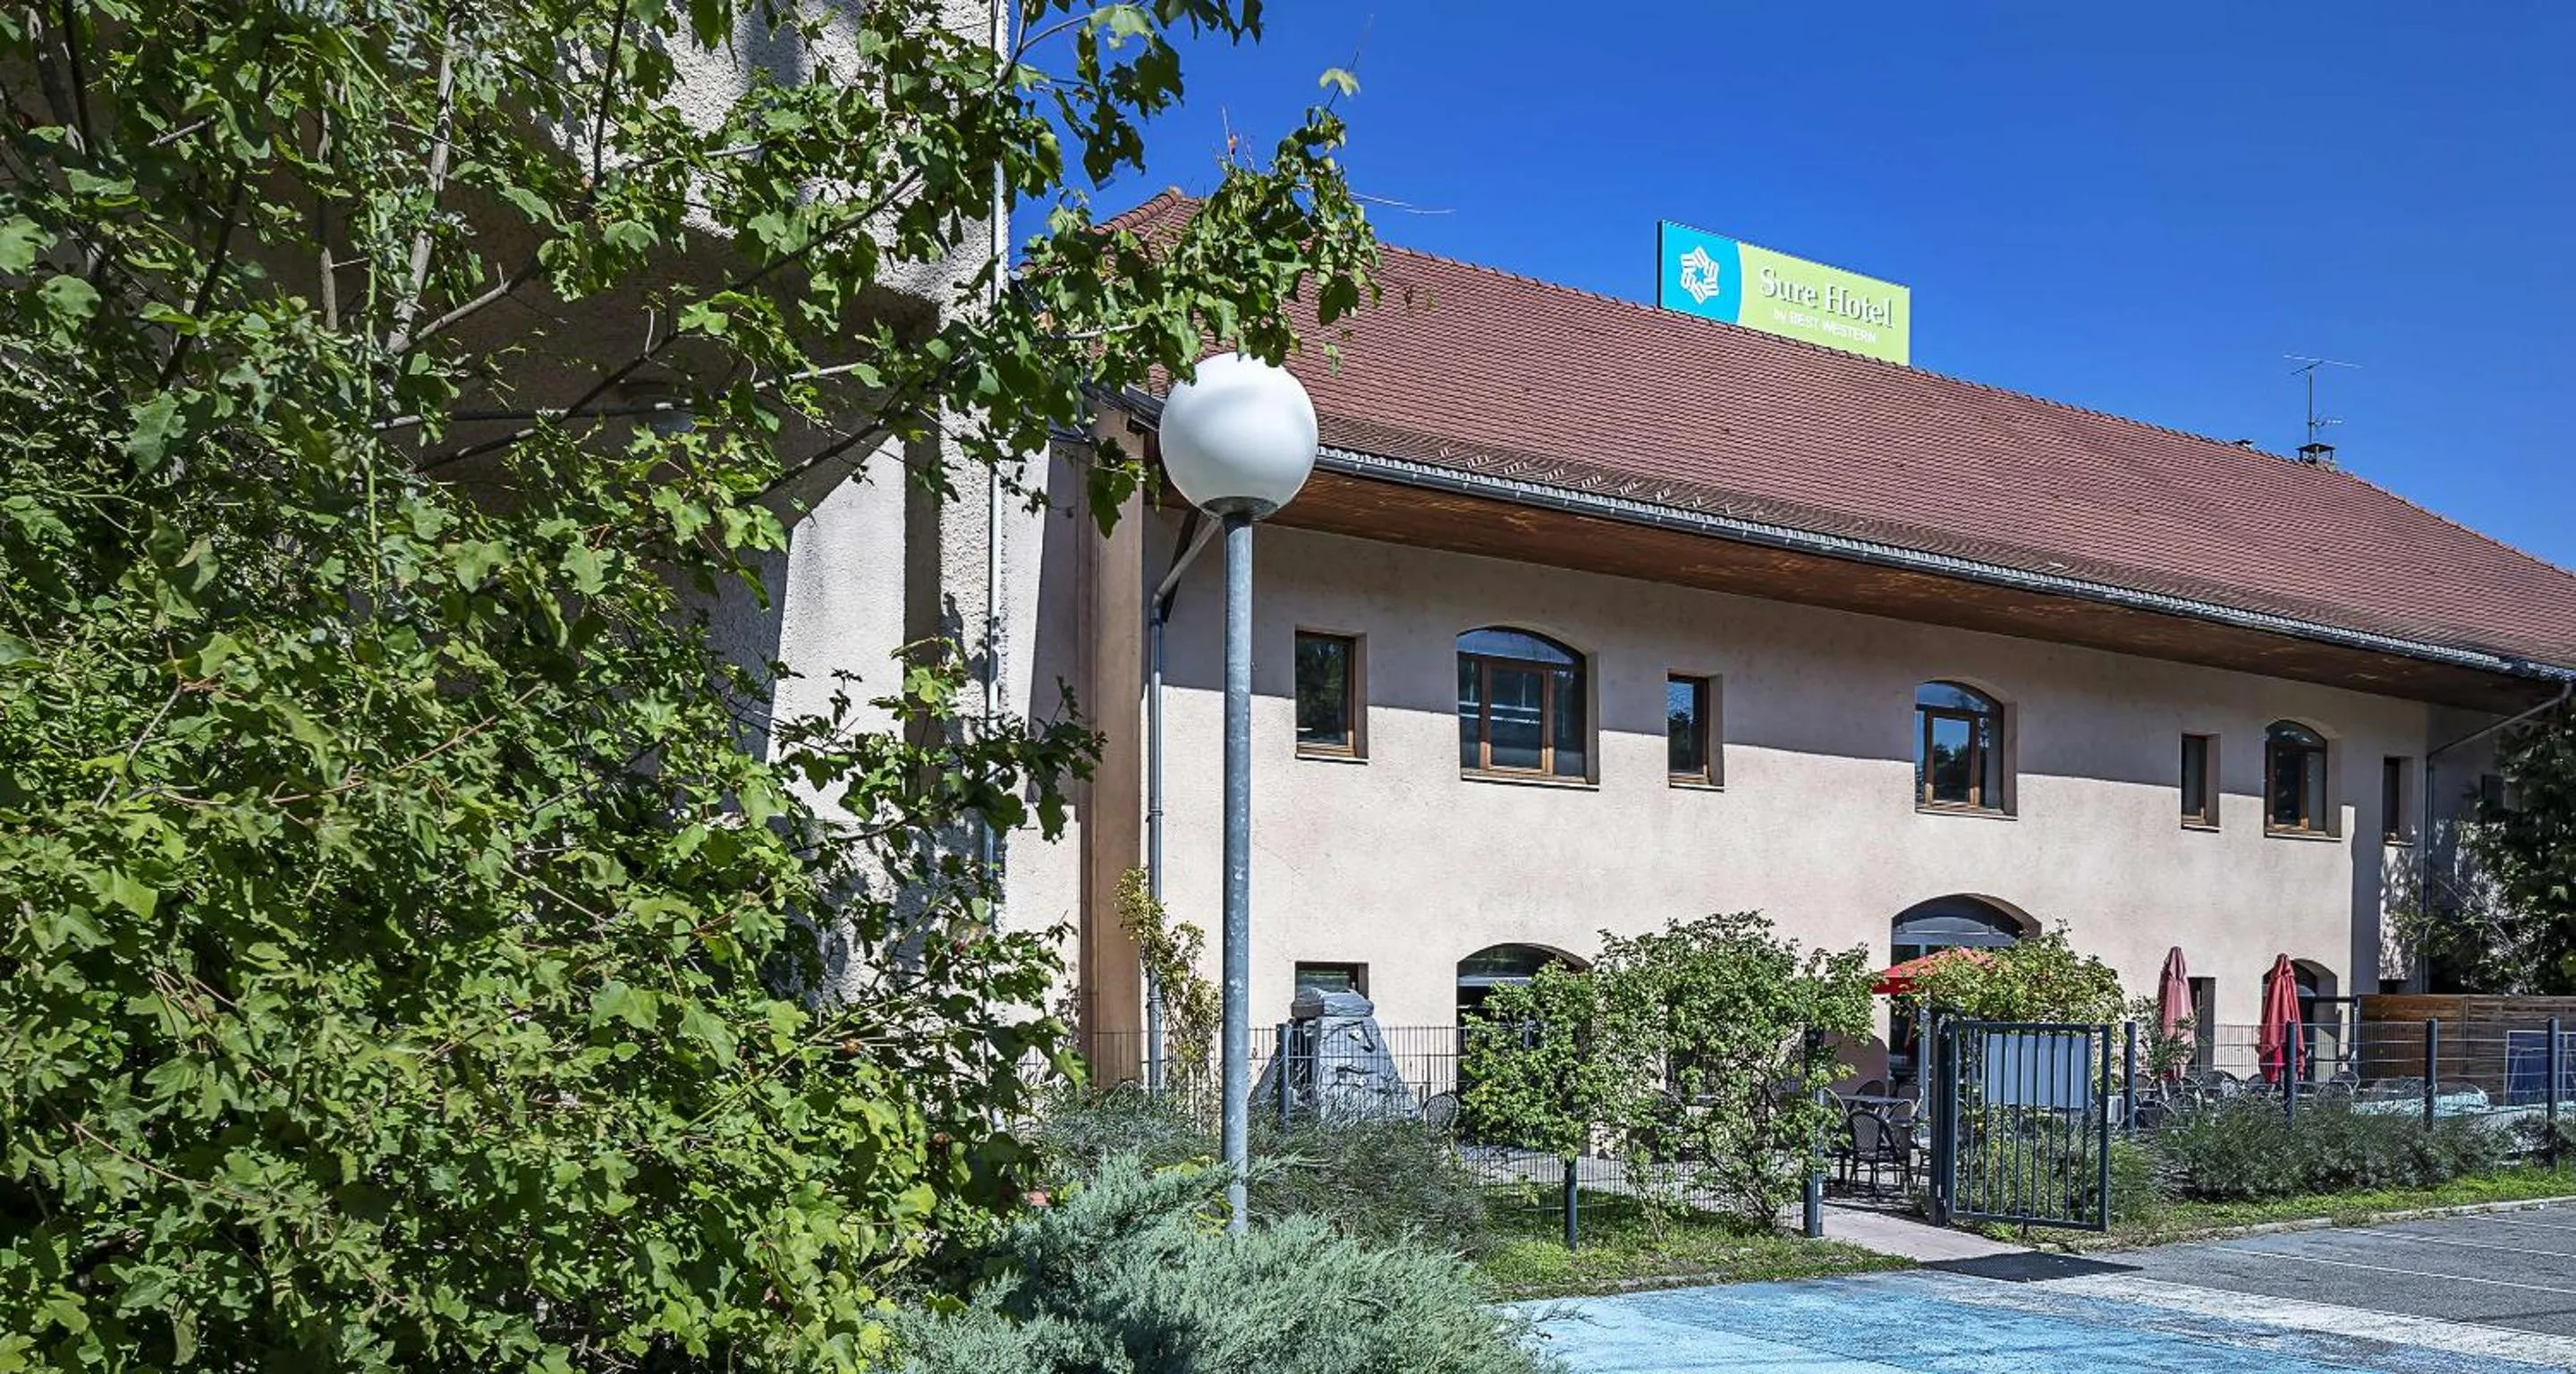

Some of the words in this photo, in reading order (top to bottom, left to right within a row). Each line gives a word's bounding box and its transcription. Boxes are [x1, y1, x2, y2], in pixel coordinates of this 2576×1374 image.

[1759, 267, 1818, 309] Sure
[1825, 284, 1894, 329] Hotel
[1773, 308, 1787, 325] by
[1790, 311, 1819, 331] BEST
[1822, 320, 1877, 344] WESTERN
